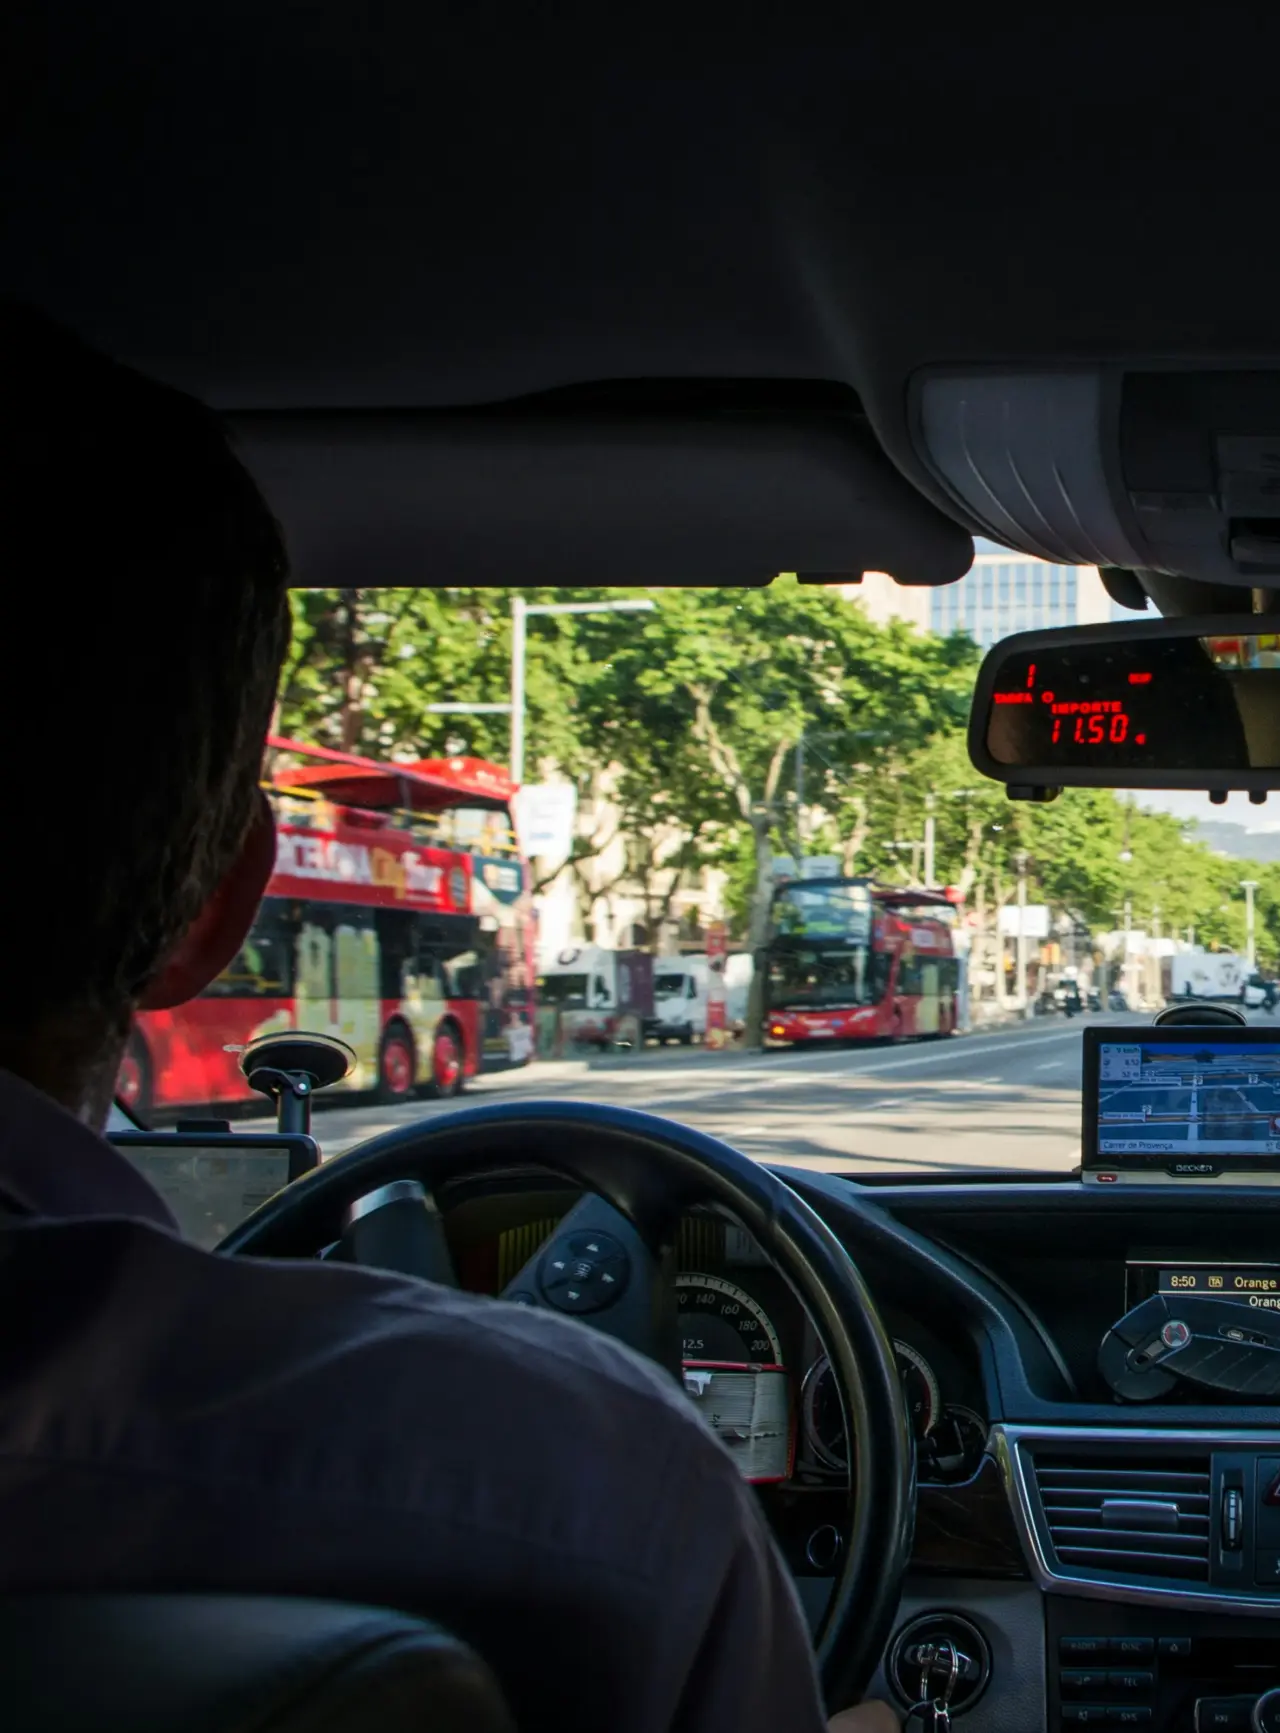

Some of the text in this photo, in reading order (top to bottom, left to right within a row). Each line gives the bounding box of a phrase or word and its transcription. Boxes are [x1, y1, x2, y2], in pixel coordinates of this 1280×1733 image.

[1051, 700, 1122, 715] IMPORTE
[1103, 1141, 1174, 1151] Carrer de Provença
[1175, 1164, 1213, 1172] BECKER
[1170, 1275, 1196, 1287] 8:50
[1234, 1276, 1277, 1289] Orange
[695, 1293, 716, 1305] 140
[720, 1304, 740, 1316] 160
[750, 1339, 770, 1351] 200
